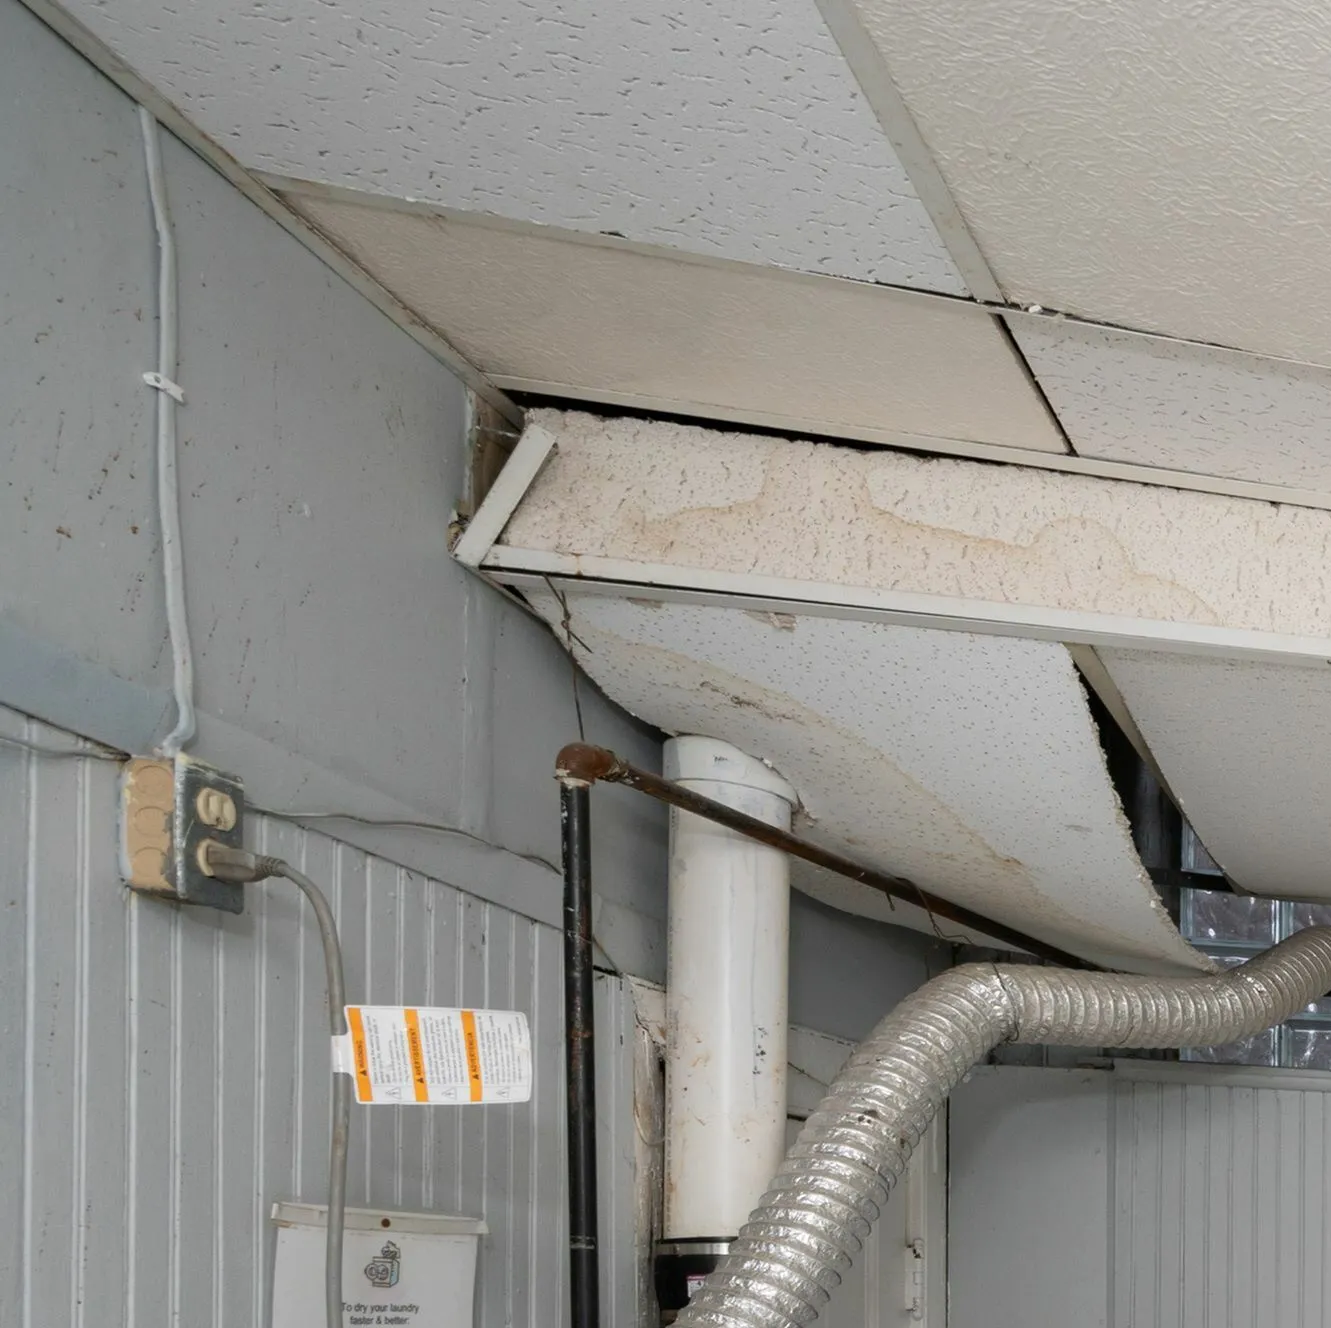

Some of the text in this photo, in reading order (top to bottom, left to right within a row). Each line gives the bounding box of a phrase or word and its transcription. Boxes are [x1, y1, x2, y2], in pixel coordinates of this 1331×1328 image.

[354, 1302, 368, 1314] dry
[370, 1303, 388, 1314] your
[390, 1303, 420, 1315] laundry
[350, 1315, 374, 1325] faster
[376, 1316, 382, 1325] &
